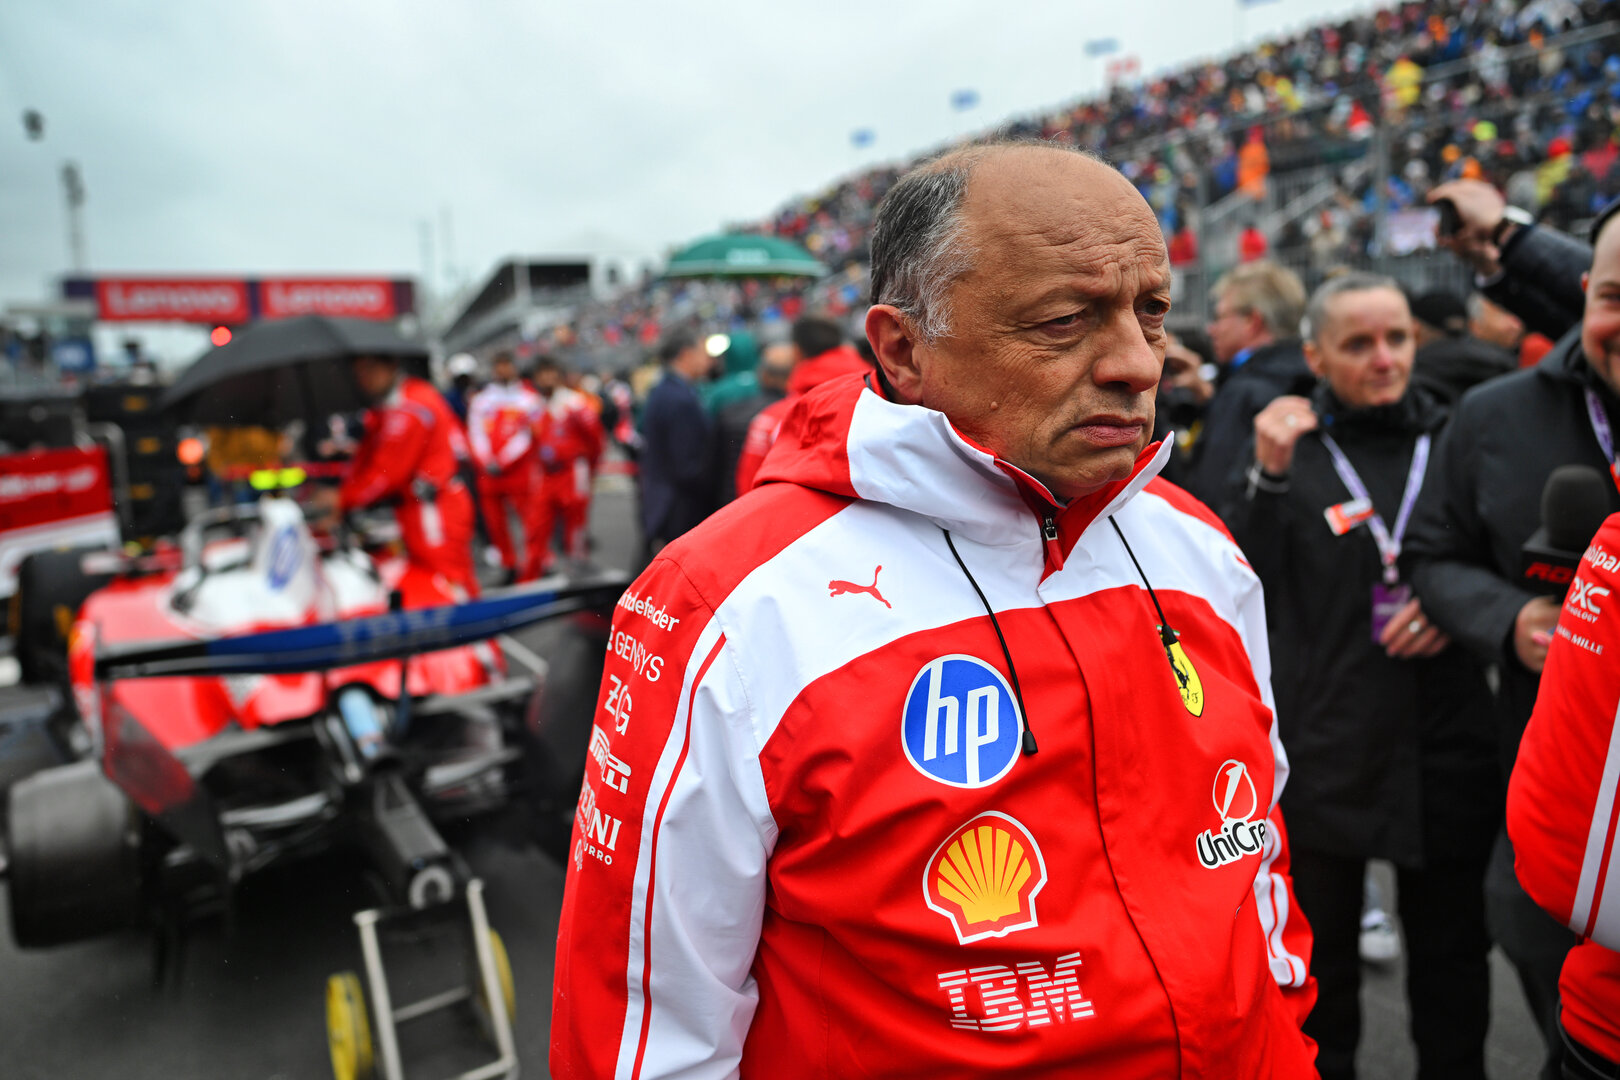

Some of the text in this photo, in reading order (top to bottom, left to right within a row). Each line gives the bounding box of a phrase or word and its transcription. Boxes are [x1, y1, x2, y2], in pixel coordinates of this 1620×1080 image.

[1571, 634, 1603, 655] MILLE
[923, 660, 1000, 785] hp
[937, 952, 1095, 1032] IBM
